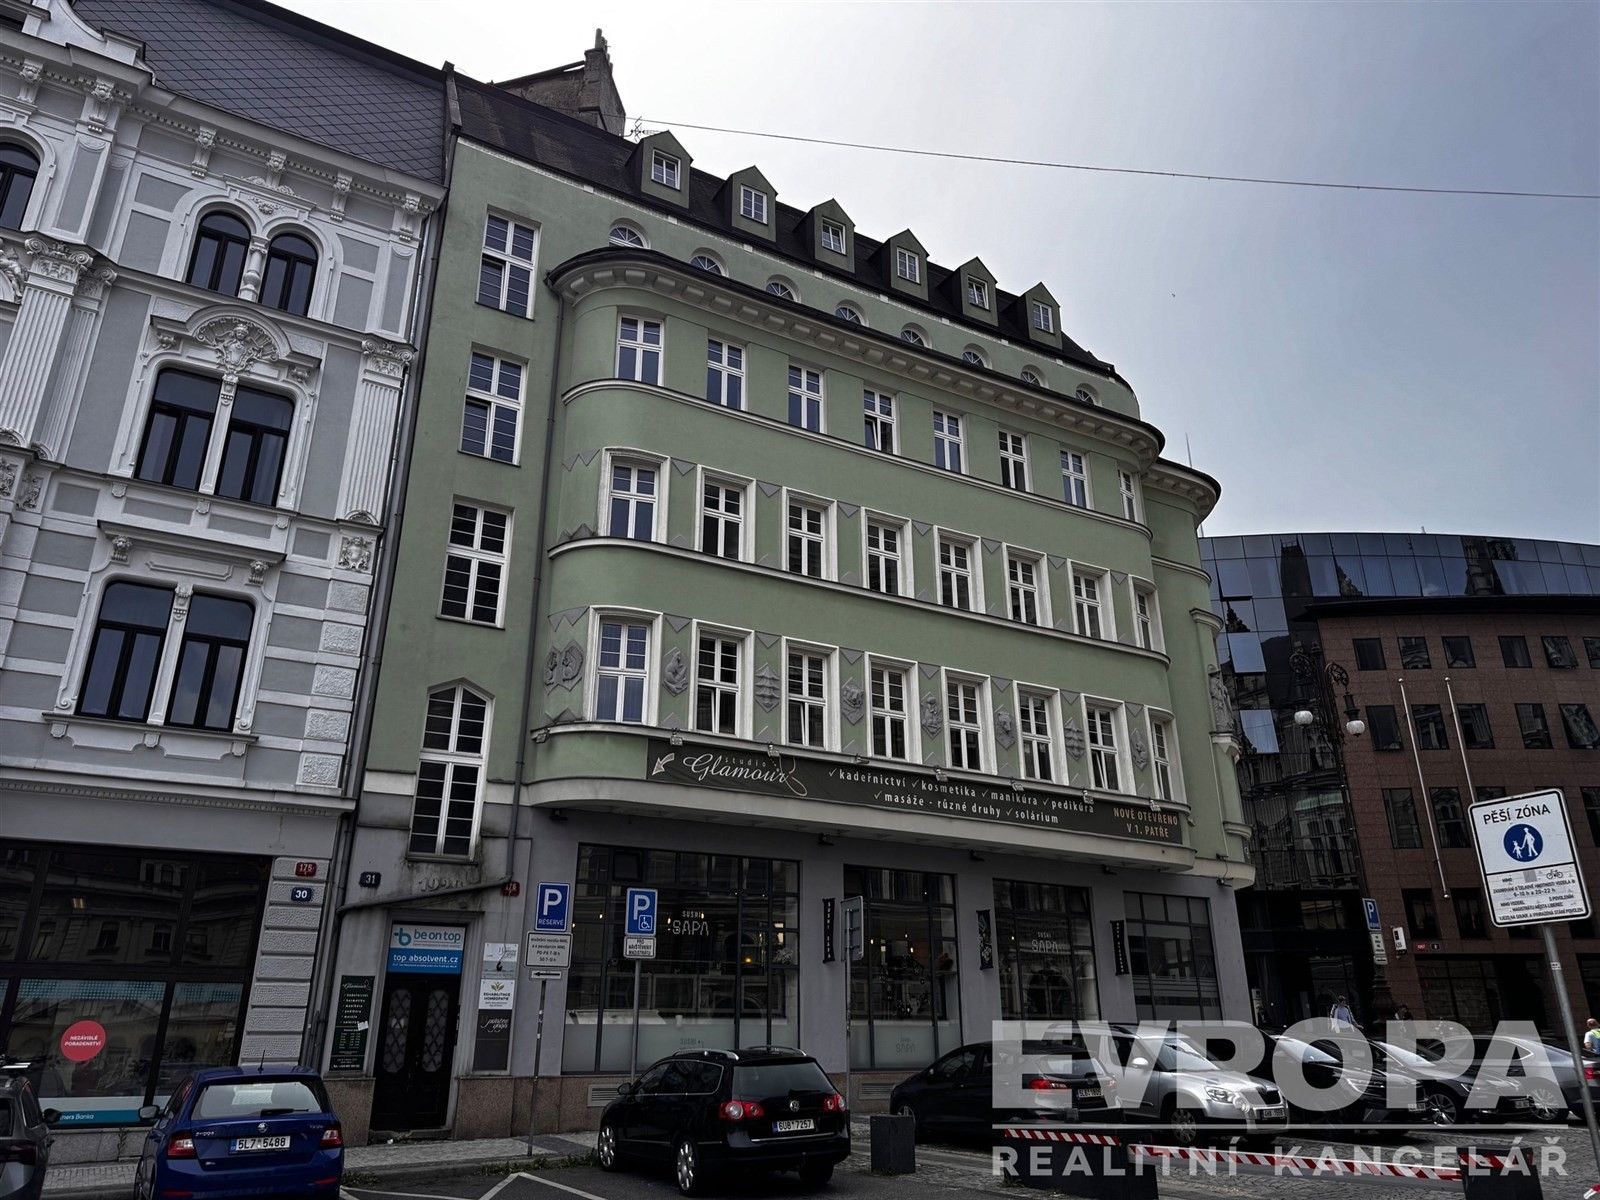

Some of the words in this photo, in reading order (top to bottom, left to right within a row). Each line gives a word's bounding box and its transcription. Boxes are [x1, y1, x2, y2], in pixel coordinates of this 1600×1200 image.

[683, 753, 788, 783] Glamour
[725, 757, 767, 767] studio
[839, 768, 906, 787] kadeřnictví
[921, 780, 976, 797] kosmetika
[990, 791, 1038, 806] manikúra
[1051, 800, 1094, 813] pedikúra
[884, 791, 924, 806] masáže
[937, 798, 967, 812] různé
[971, 802, 1001, 818] druhy
[1015, 809, 1059, 824] solárium
[1483, 808, 1511, 825] PĚŠÍ
[1515, 803, 1551, 819] ZÓNA
[1126, 823, 1132, 833] V
[1144, 825, 1169, 838] PATŘE
[365, 874, 376, 884] 31
[295, 890, 308, 899] 30
[543, 888, 562, 916] P
[633, 894, 650, 920] P
[414, 929, 427, 940] be
[428, 931, 441, 940] on
[444, 930, 461, 943] top
[393, 954, 407, 963] top
[408, 954, 458, 963] absolvent.cz
[238, 1139, 256, 1149] 5L7
[263, 1137, 286, 1148] 5488
